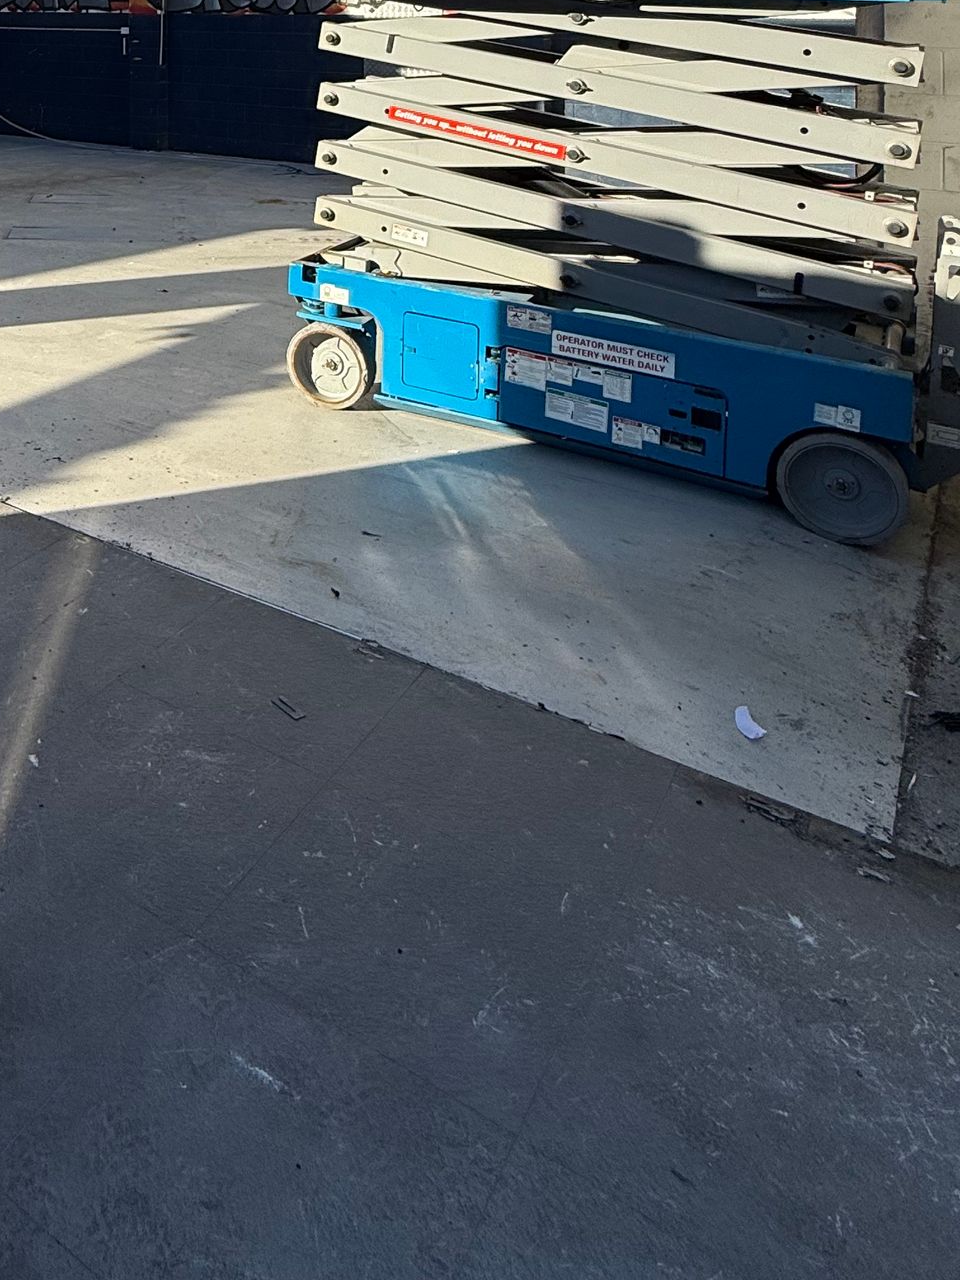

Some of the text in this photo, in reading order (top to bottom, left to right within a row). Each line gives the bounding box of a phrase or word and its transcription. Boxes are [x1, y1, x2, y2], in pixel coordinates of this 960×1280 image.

[394, 109, 423, 125] Getting
[422, 116, 438, 127] you
[488, 131, 516, 146] letting
[516, 138, 533, 149] you
[533, 142, 559, 155] down
[556, 333, 670, 363] OPERATOR MUST CHECK
[559, 344, 666, 373] BATTERY WATER DAILY
